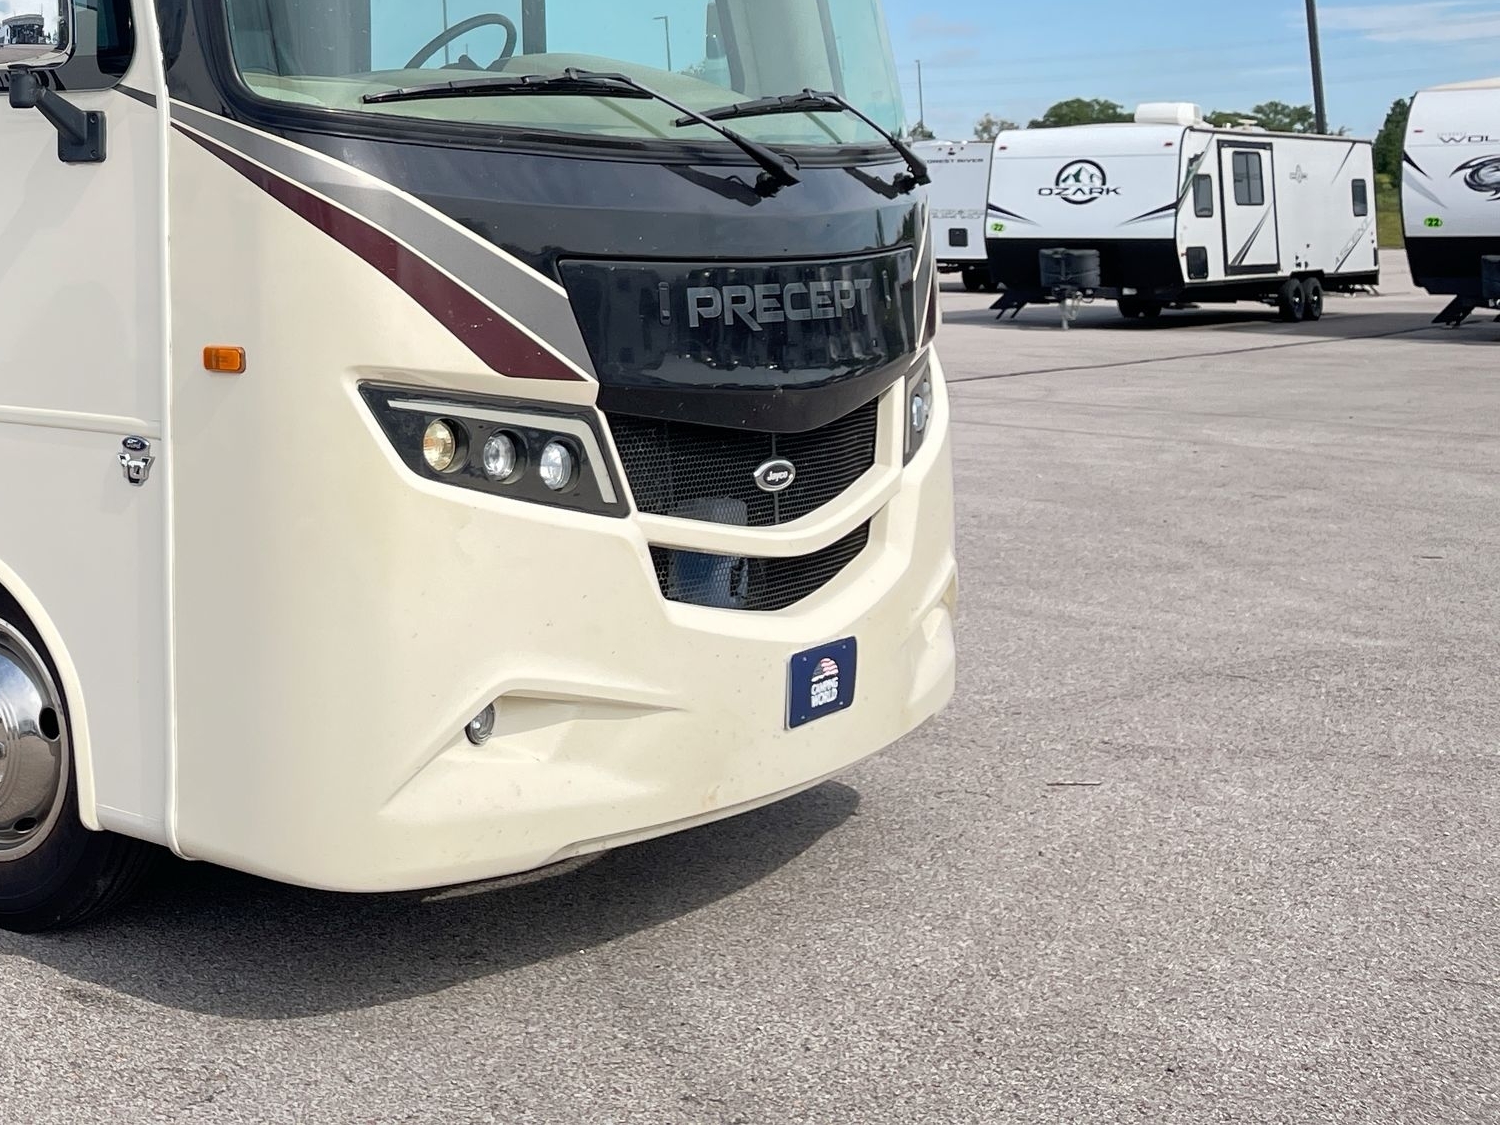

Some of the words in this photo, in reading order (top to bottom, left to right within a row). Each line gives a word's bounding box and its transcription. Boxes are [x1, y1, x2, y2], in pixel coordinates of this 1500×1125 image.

[1037, 187, 1121, 196] OZARK
[1427, 218, 1439, 227] 22
[686, 278, 873, 332] PRECEPT
[767, 470, 788, 482] Jayco
[811, 687, 838, 708] WORLD
